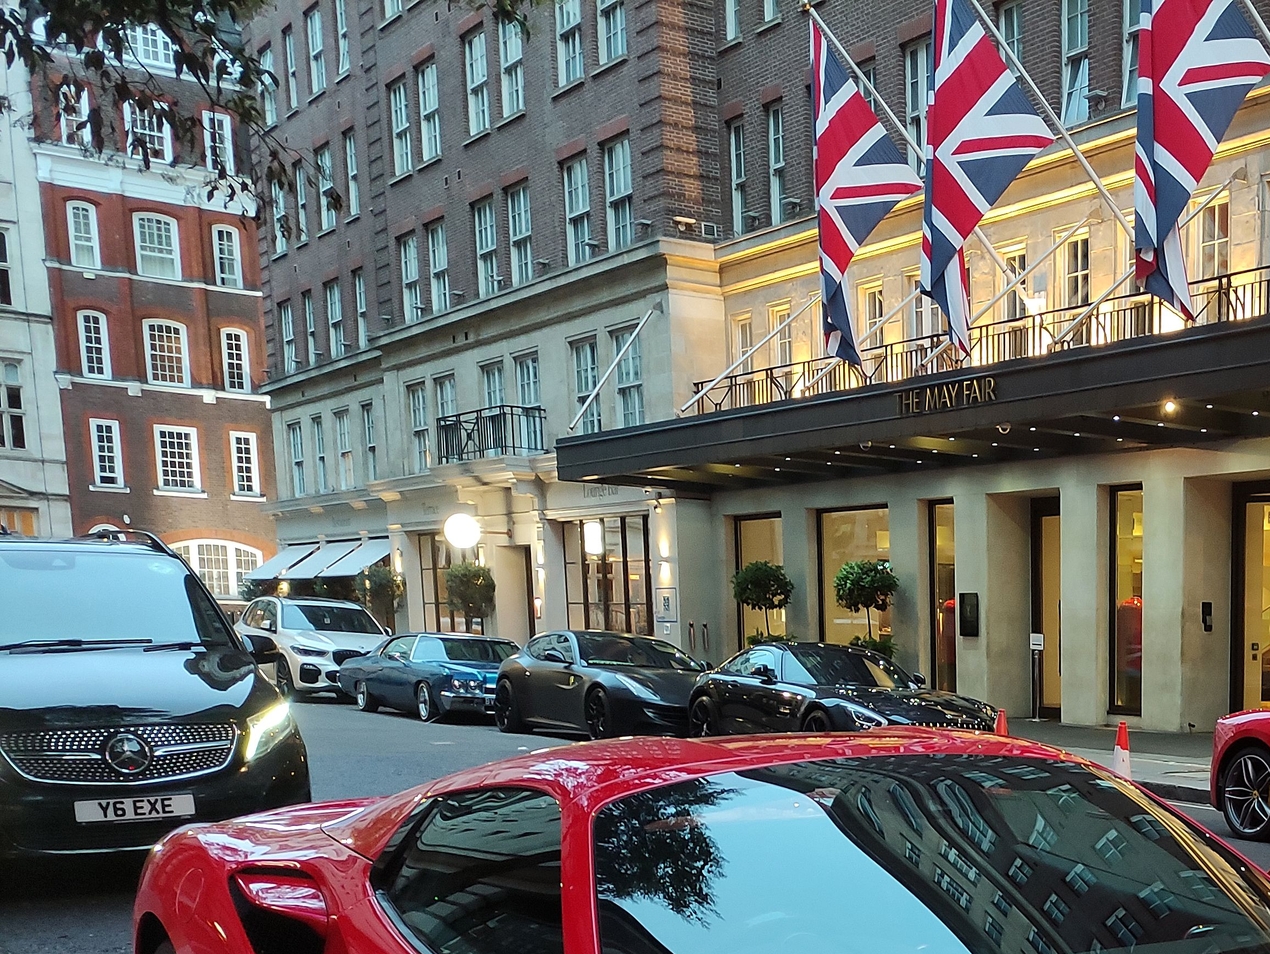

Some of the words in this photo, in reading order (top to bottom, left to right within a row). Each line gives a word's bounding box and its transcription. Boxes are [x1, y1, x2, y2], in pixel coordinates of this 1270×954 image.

[893, 389, 920, 414] THE
[925, 383, 959, 411] MAY
[963, 377, 996, 405] FAIR
[98, 800, 127, 818] Y6
[133, 797, 174, 816] EXE
